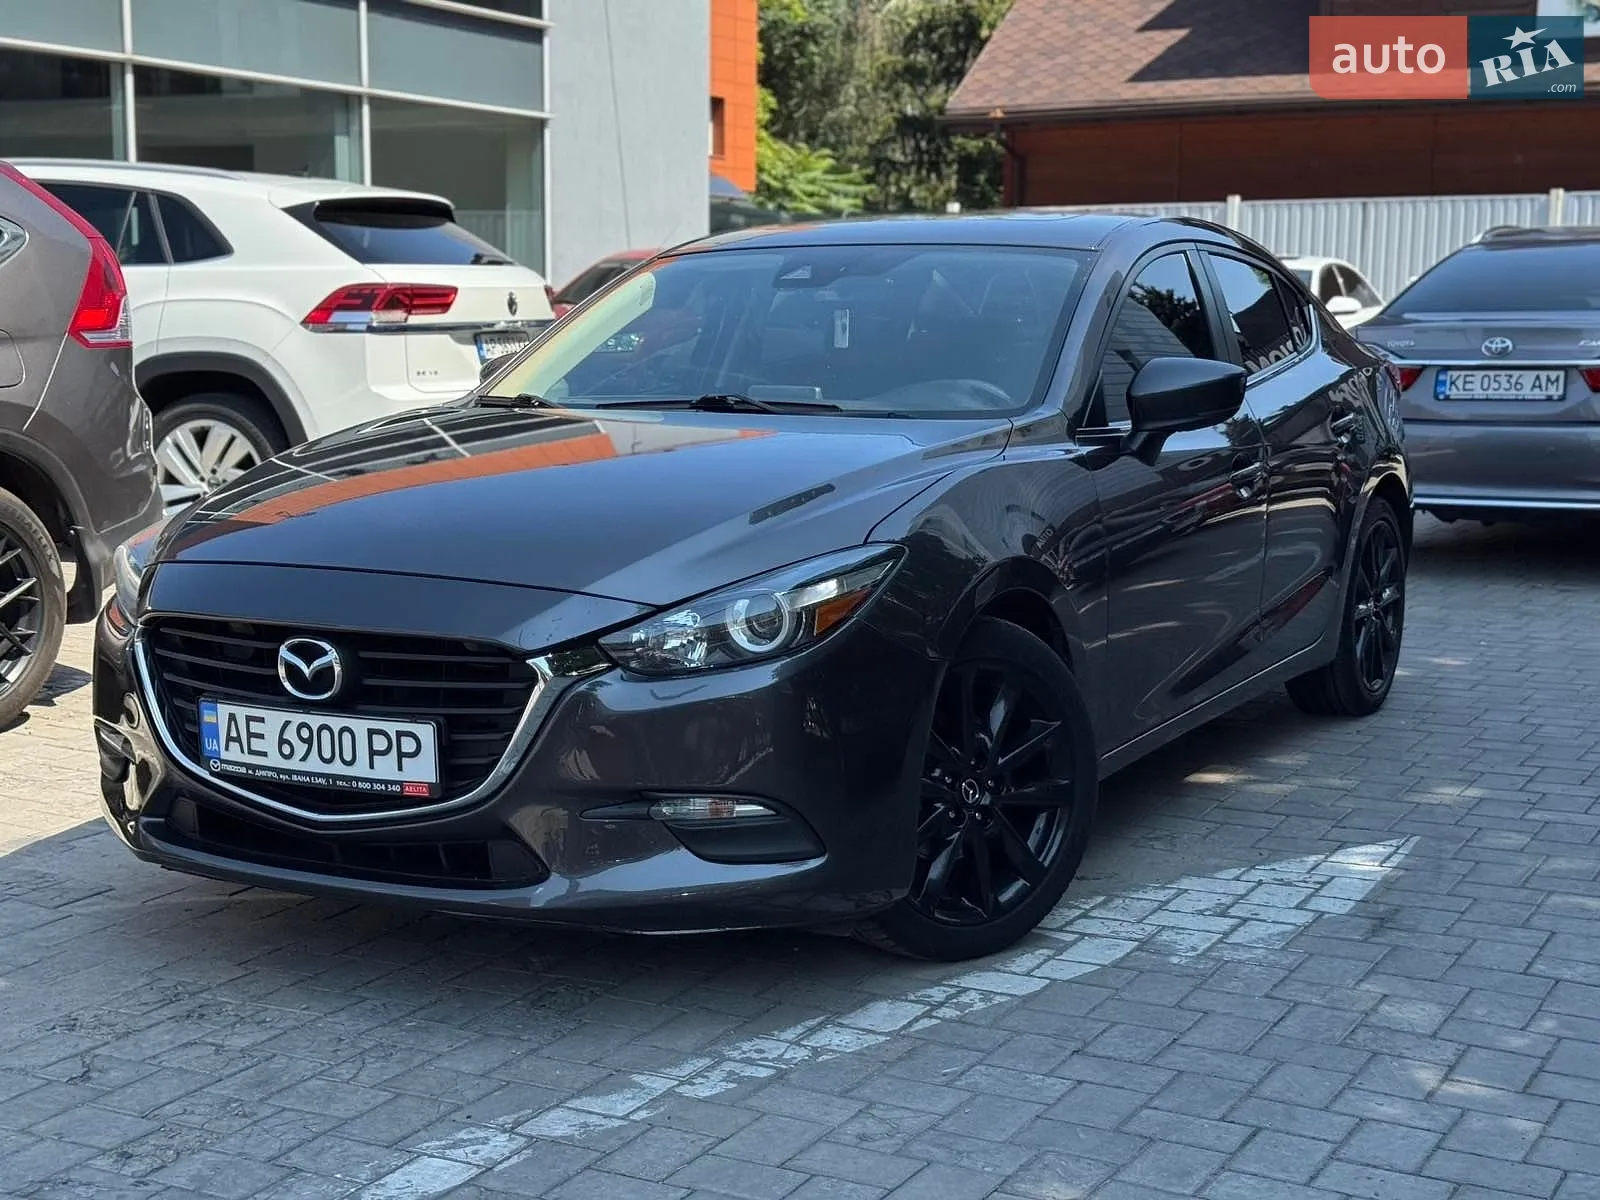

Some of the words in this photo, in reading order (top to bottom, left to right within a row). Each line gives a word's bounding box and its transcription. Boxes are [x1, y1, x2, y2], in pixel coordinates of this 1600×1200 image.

[1448, 374, 1476, 392] KE
[1480, 374, 1525, 392] 0536
[1530, 374, 1561, 392] AM
[205, 737, 219, 752] UA
[225, 712, 268, 757] AE
[277, 720, 357, 766] 6900
[366, 728, 422, 772] PP
[372, 782, 386, 791] 304
[387, 784, 401, 792] 340
